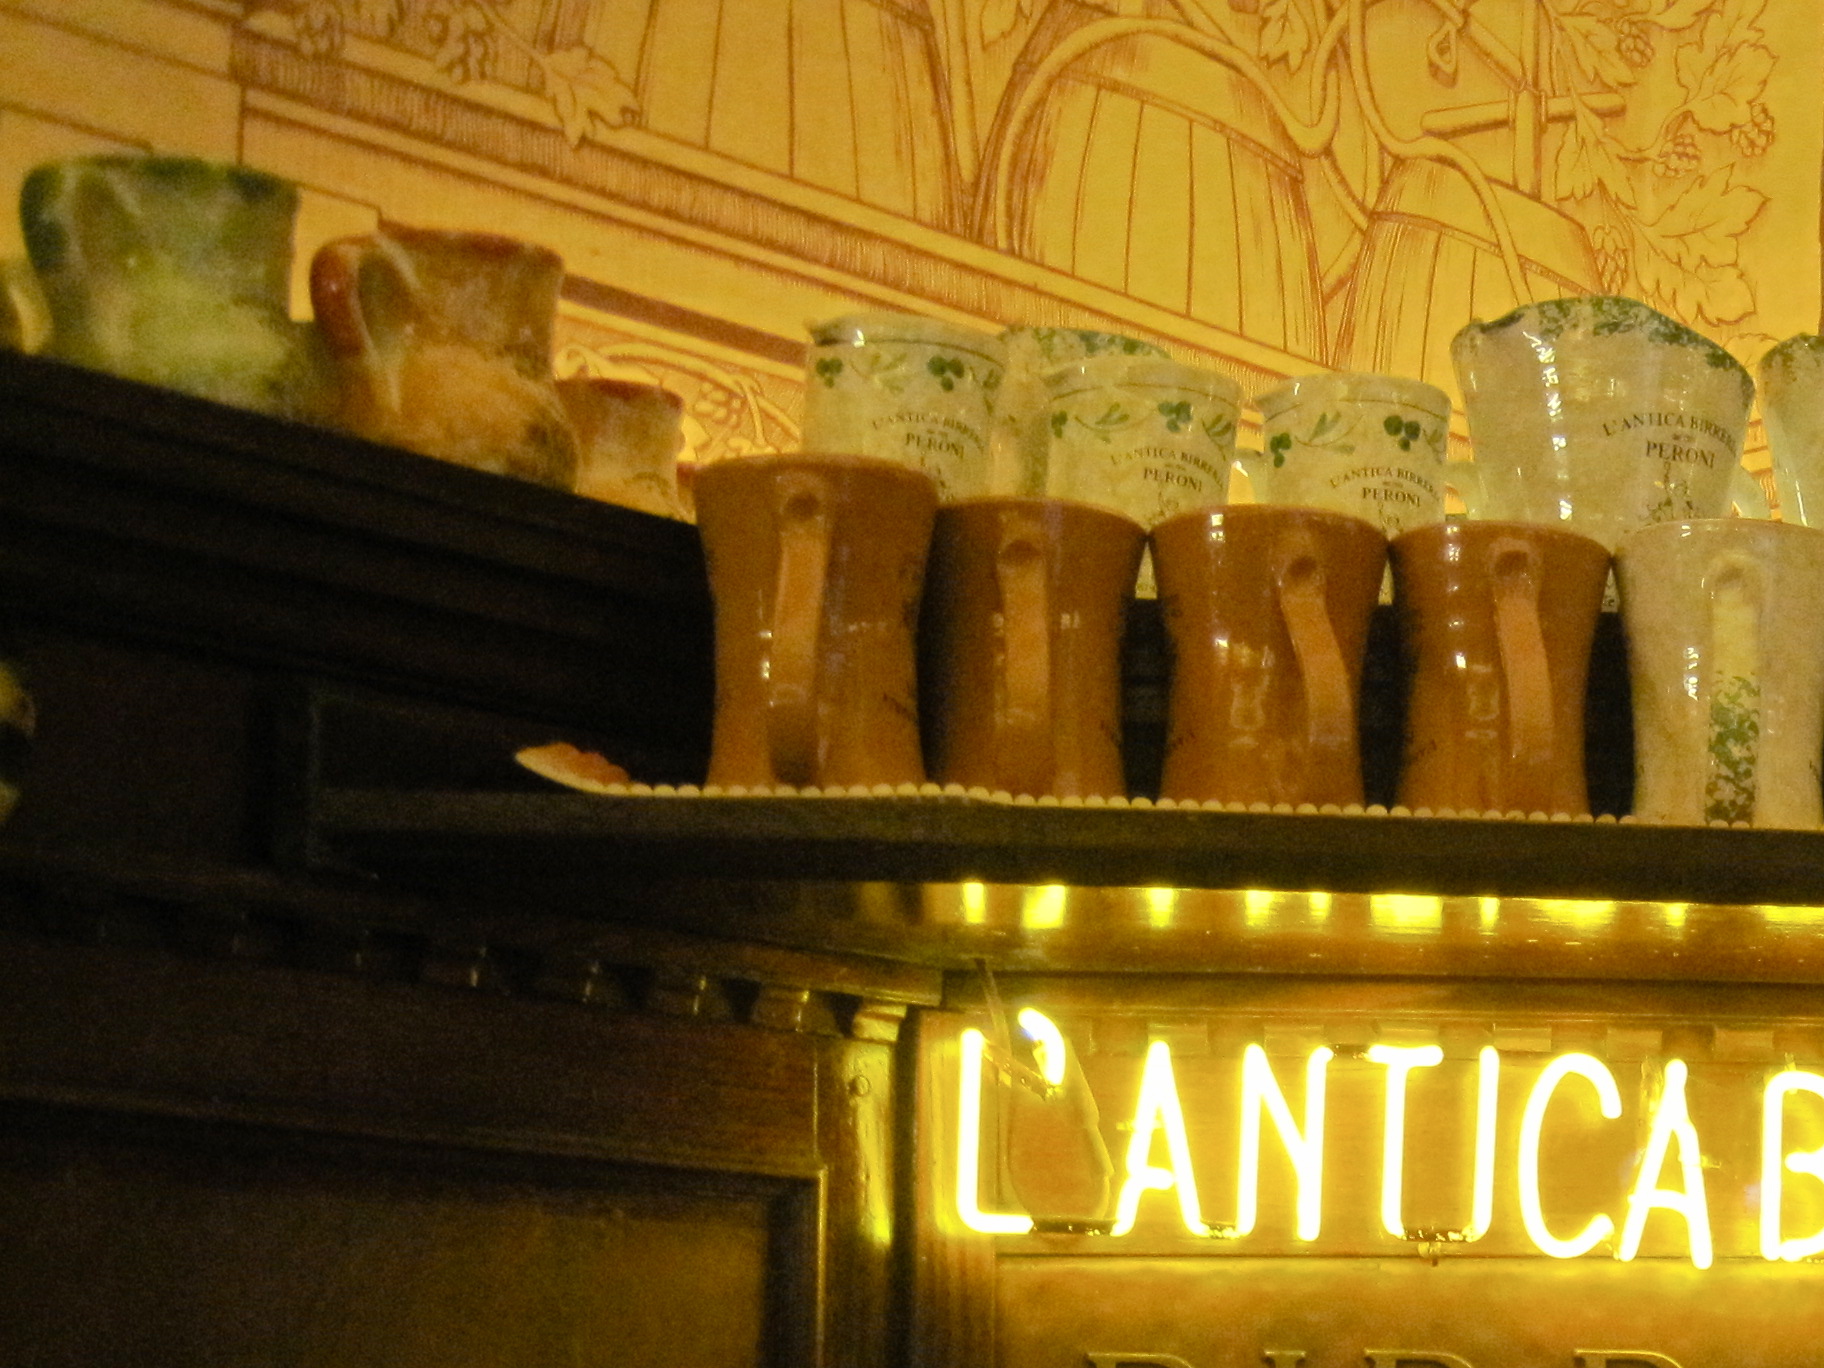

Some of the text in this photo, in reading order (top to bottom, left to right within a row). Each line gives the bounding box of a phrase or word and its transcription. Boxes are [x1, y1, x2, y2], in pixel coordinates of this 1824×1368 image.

[1602, 411, 1685, 437] L'ANTICA
[905, 432, 965, 460] PERONI
[1110, 446, 1176, 466] L'ANTICA
[1646, 440, 1715, 470] PERONI
[1143, 467, 1203, 493] PERONI
[1329, 466, 1393, 489] L'ANTICA
[1361, 487, 1421, 508] PERONI
[956, 1005, 1716, 1271] L'ANTICA
